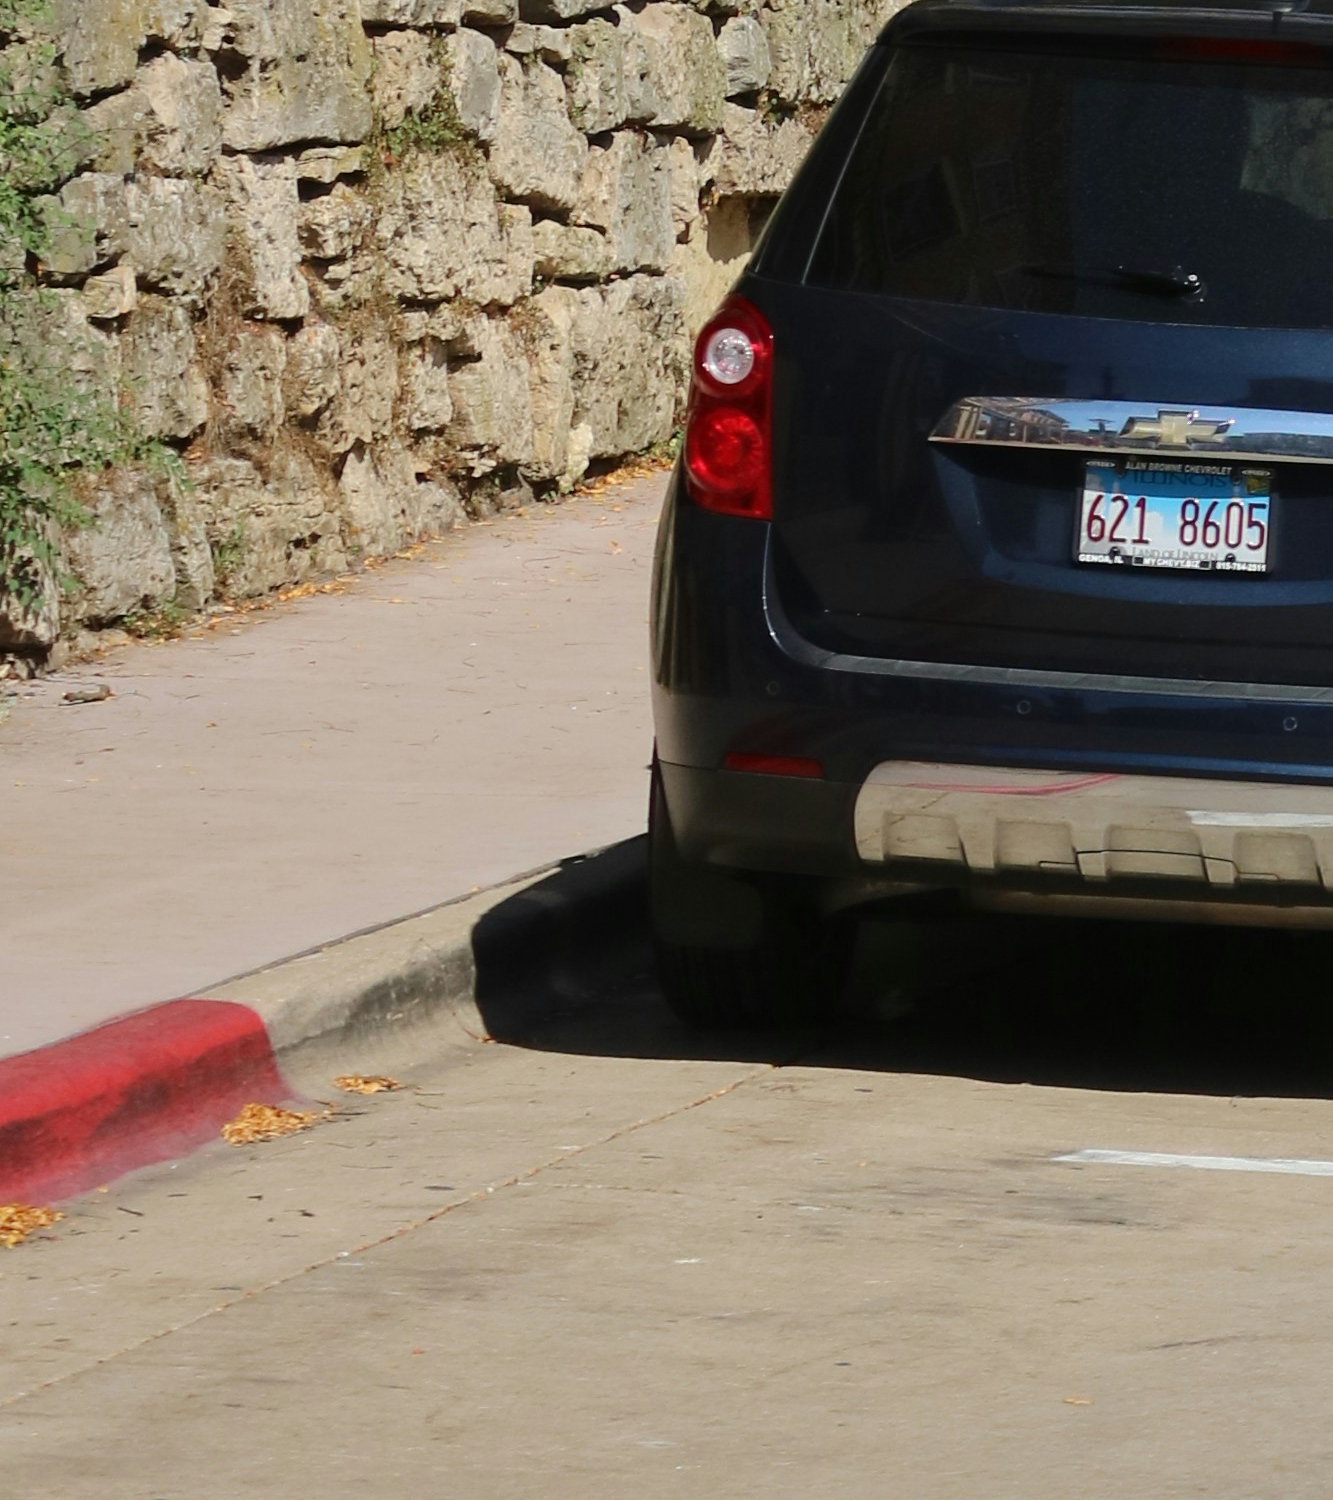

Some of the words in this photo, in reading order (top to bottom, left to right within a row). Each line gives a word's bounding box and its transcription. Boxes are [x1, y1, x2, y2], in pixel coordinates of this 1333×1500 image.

[1125, 461, 1147, 471] ALAN
[1184, 465, 1233, 476] CHEVROLET
[1132, 470, 1227, 488] ILLINOIS
[1086, 494, 1150, 545] 621
[1179, 498, 1268, 550] 8605
